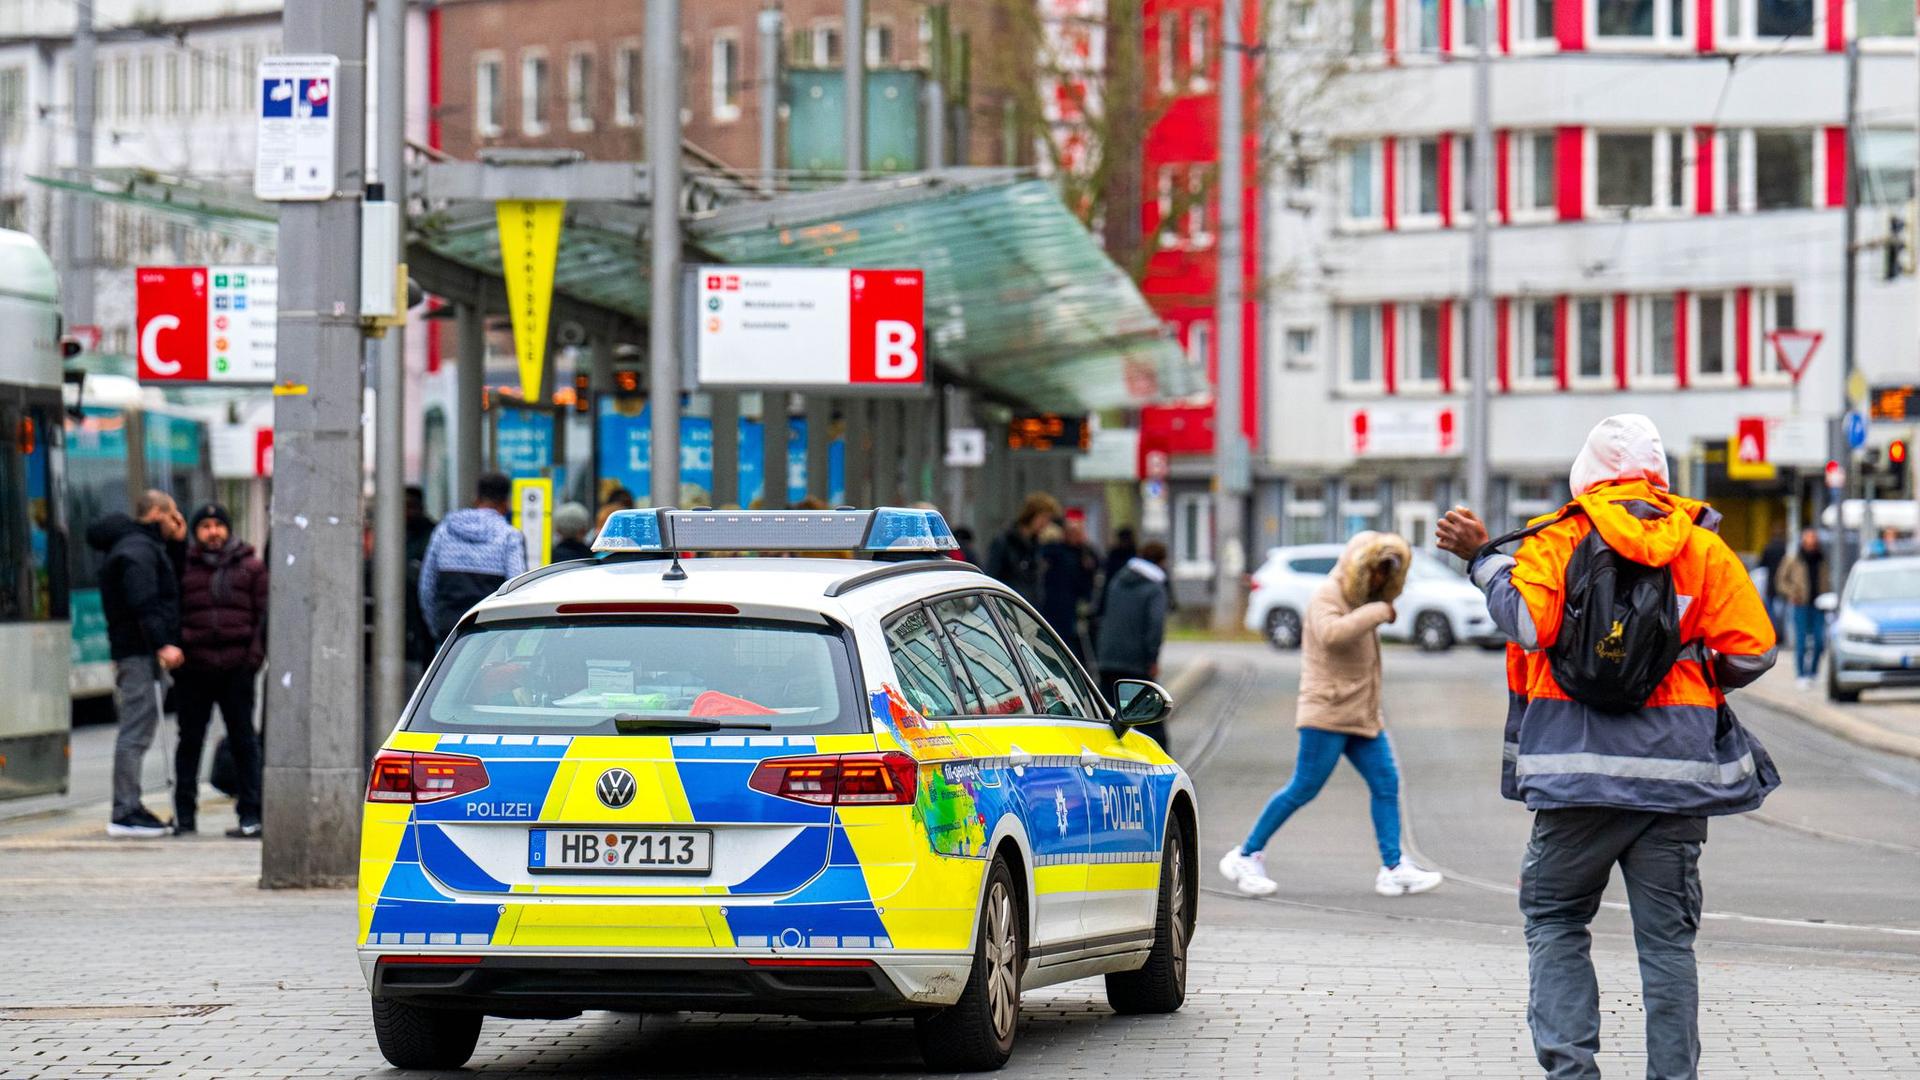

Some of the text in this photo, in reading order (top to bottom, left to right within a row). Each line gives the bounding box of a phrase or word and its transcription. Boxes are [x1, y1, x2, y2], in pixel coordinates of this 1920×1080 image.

[141, 314, 182, 375] C
[875, 319, 918, 379] B
[1739, 434, 1760, 461] A
[597, 769, 635, 807] VW
[466, 803, 532, 817] POLIZEI
[1100, 784, 1144, 831] POLIZEI
[534, 852, 541, 861] D
[561, 834, 694, 864] HB 7113
